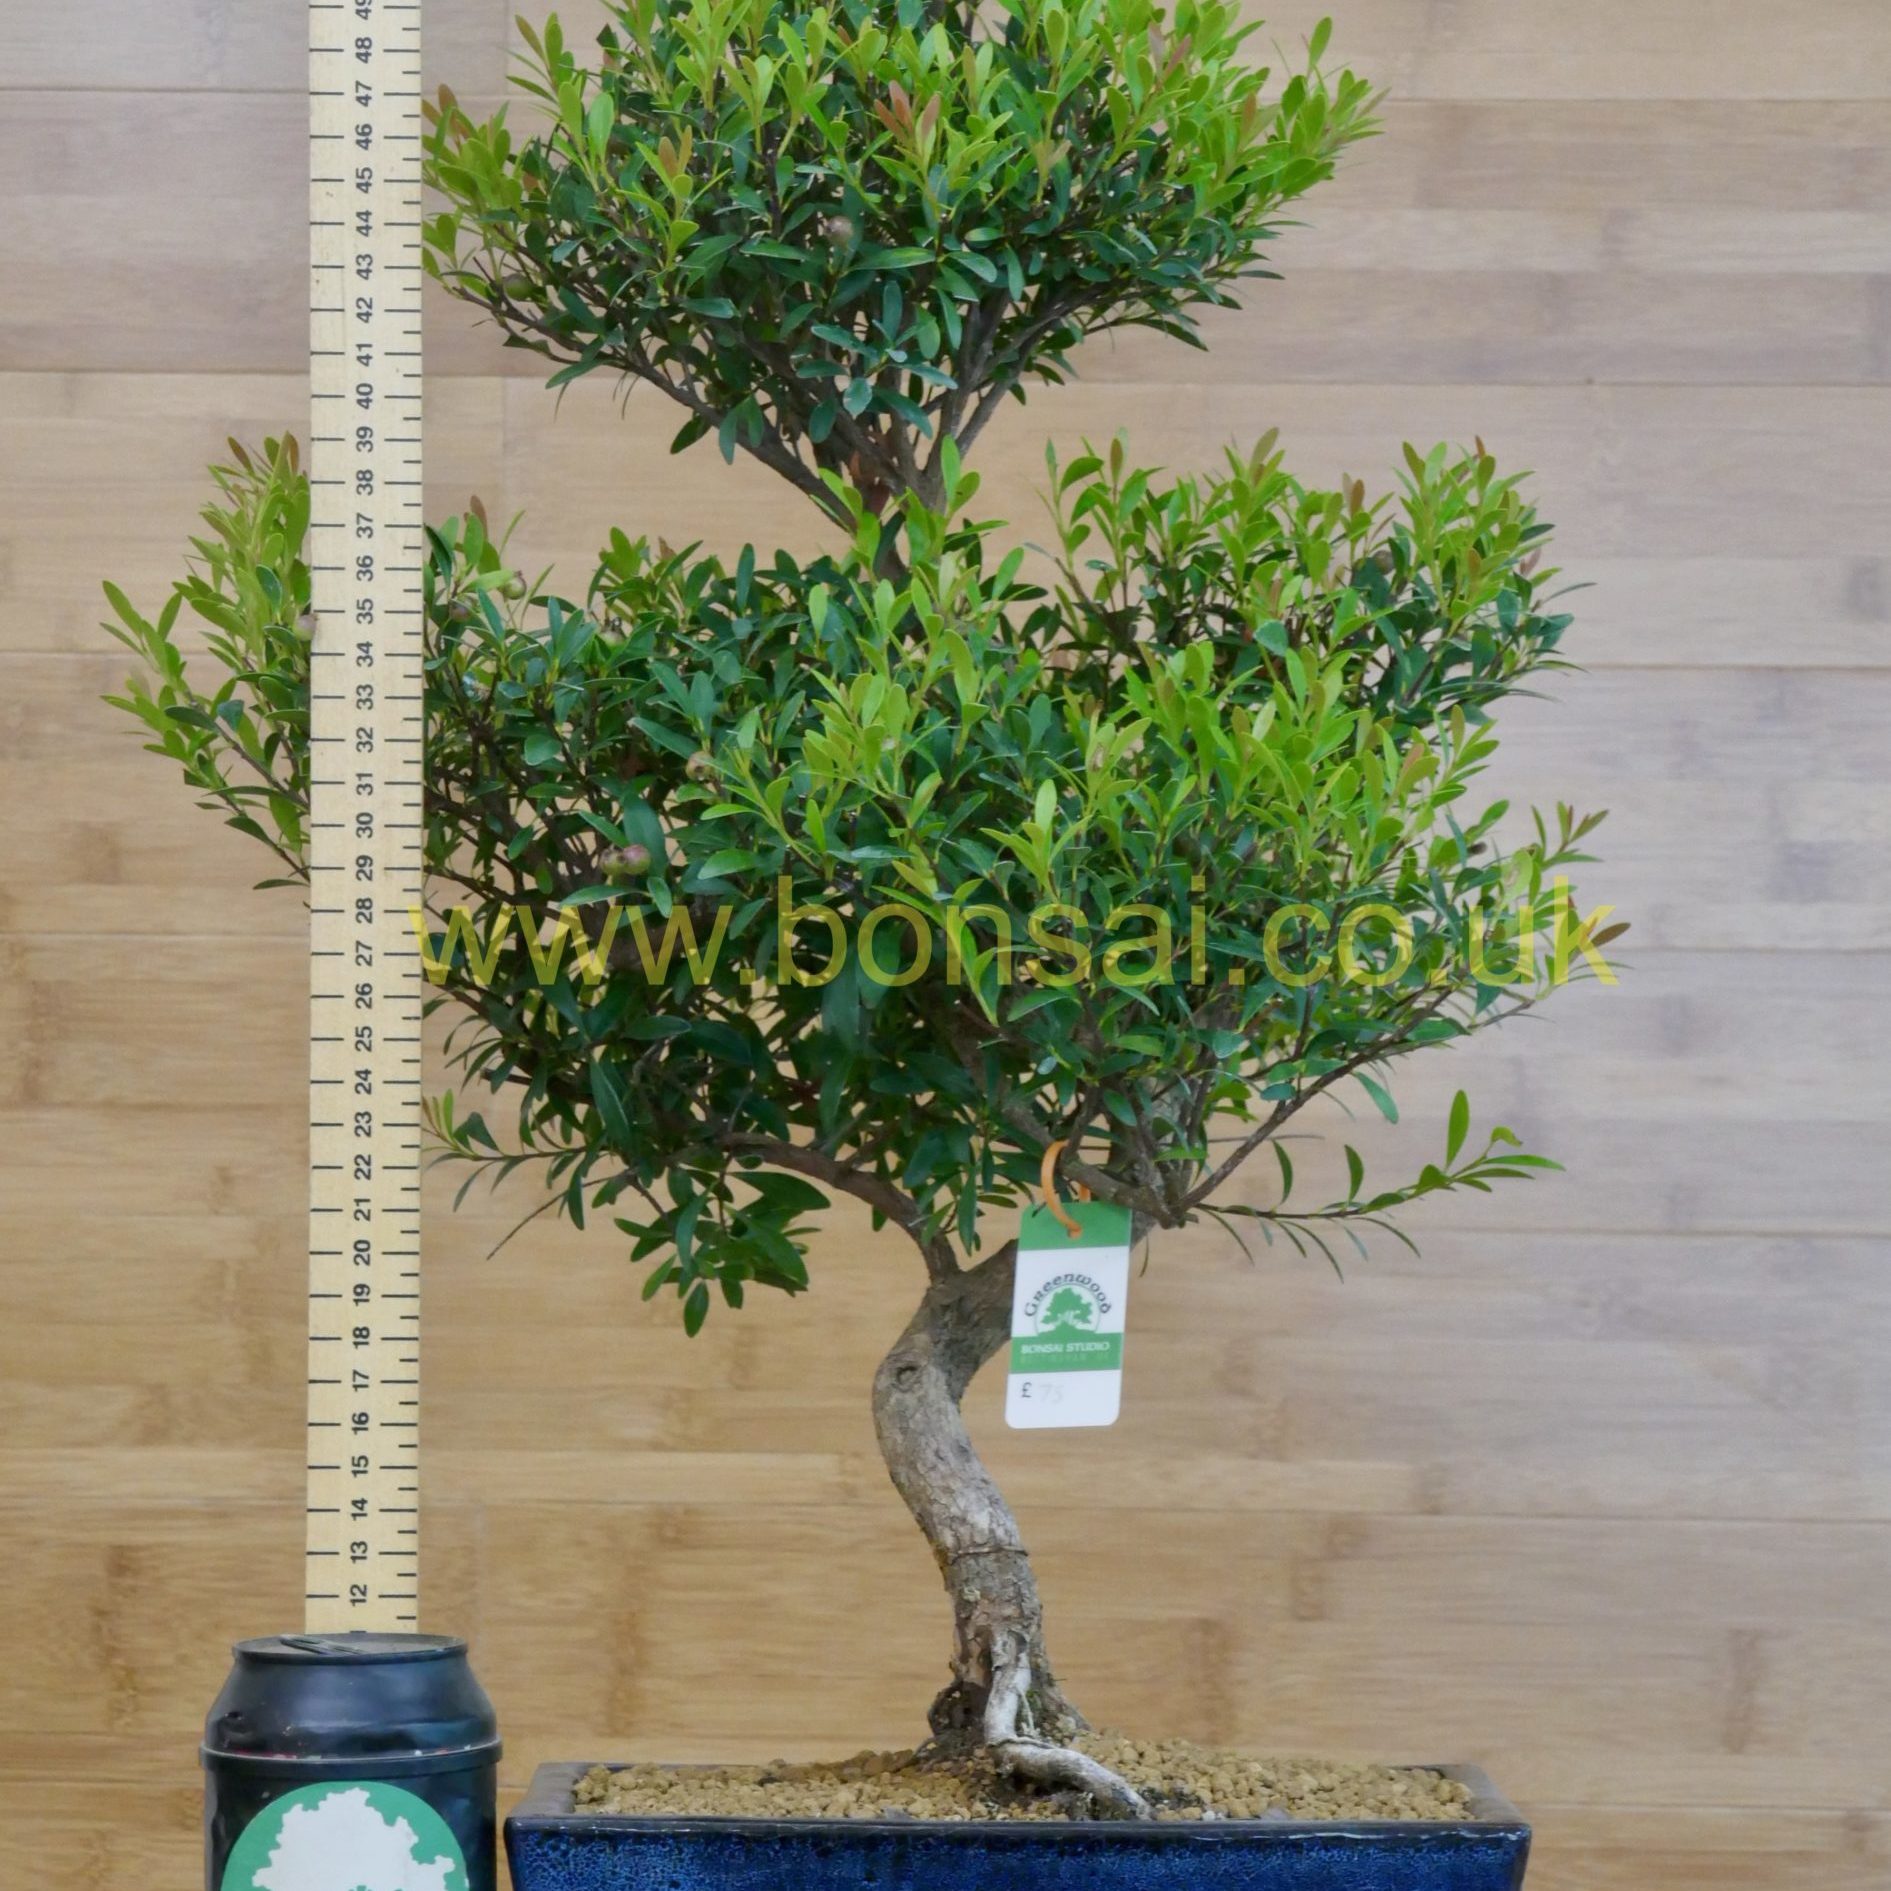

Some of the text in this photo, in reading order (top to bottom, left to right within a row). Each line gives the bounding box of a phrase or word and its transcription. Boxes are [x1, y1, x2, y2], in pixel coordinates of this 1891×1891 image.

[355, 37, 373, 64] 48
[355, 80, 372, 107] 47
[355, 123, 373, 151] 46
[355, 167, 373, 194] 45
[355, 210, 373, 237] 44
[355, 253, 373, 281] 43
[355, 297, 373, 324] 42
[356, 343, 373, 367] 41
[355, 383, 373, 410] 40
[356, 426, 374, 453] 39
[355, 469, 374, 496] 38
[355, 512, 374, 539] 37
[356, 555, 374, 582] 36
[355, 598, 374, 625] 35
[355, 641, 374, 668] 34
[355, 684, 374, 711] 33
[355, 726, 374, 753] 32
[355, 772, 374, 796] 31
[355, 812, 374, 839] 30
[355, 854, 374, 882] 29
[355, 897, 373, 924] 28
[355, 940, 373, 967] 27
[354, 982, 373, 1010] 26
[354, 1025, 373, 1053] 25
[354, 1068, 372, 1095] 24
[353, 1111, 373, 1138] 23
[353, 1154, 372, 1181] 22
[353, 1198, 371, 1222] 21
[353, 1239, 371, 1267] 20
[352, 1283, 371, 1307] 19
[1024, 1273, 1112, 1317] Greenwood
[352, 1326, 371, 1349] 18
[1020, 1341, 1110, 1354] BONSAI STUDIO
[352, 1369, 370, 1392] 17
[351, 1411, 370, 1435] 16
[351, 1454, 369, 1478] 15
[350, 1497, 368, 1521] 14
[349, 1540, 368, 1564] 13
[349, 1583, 368, 1607] 12
